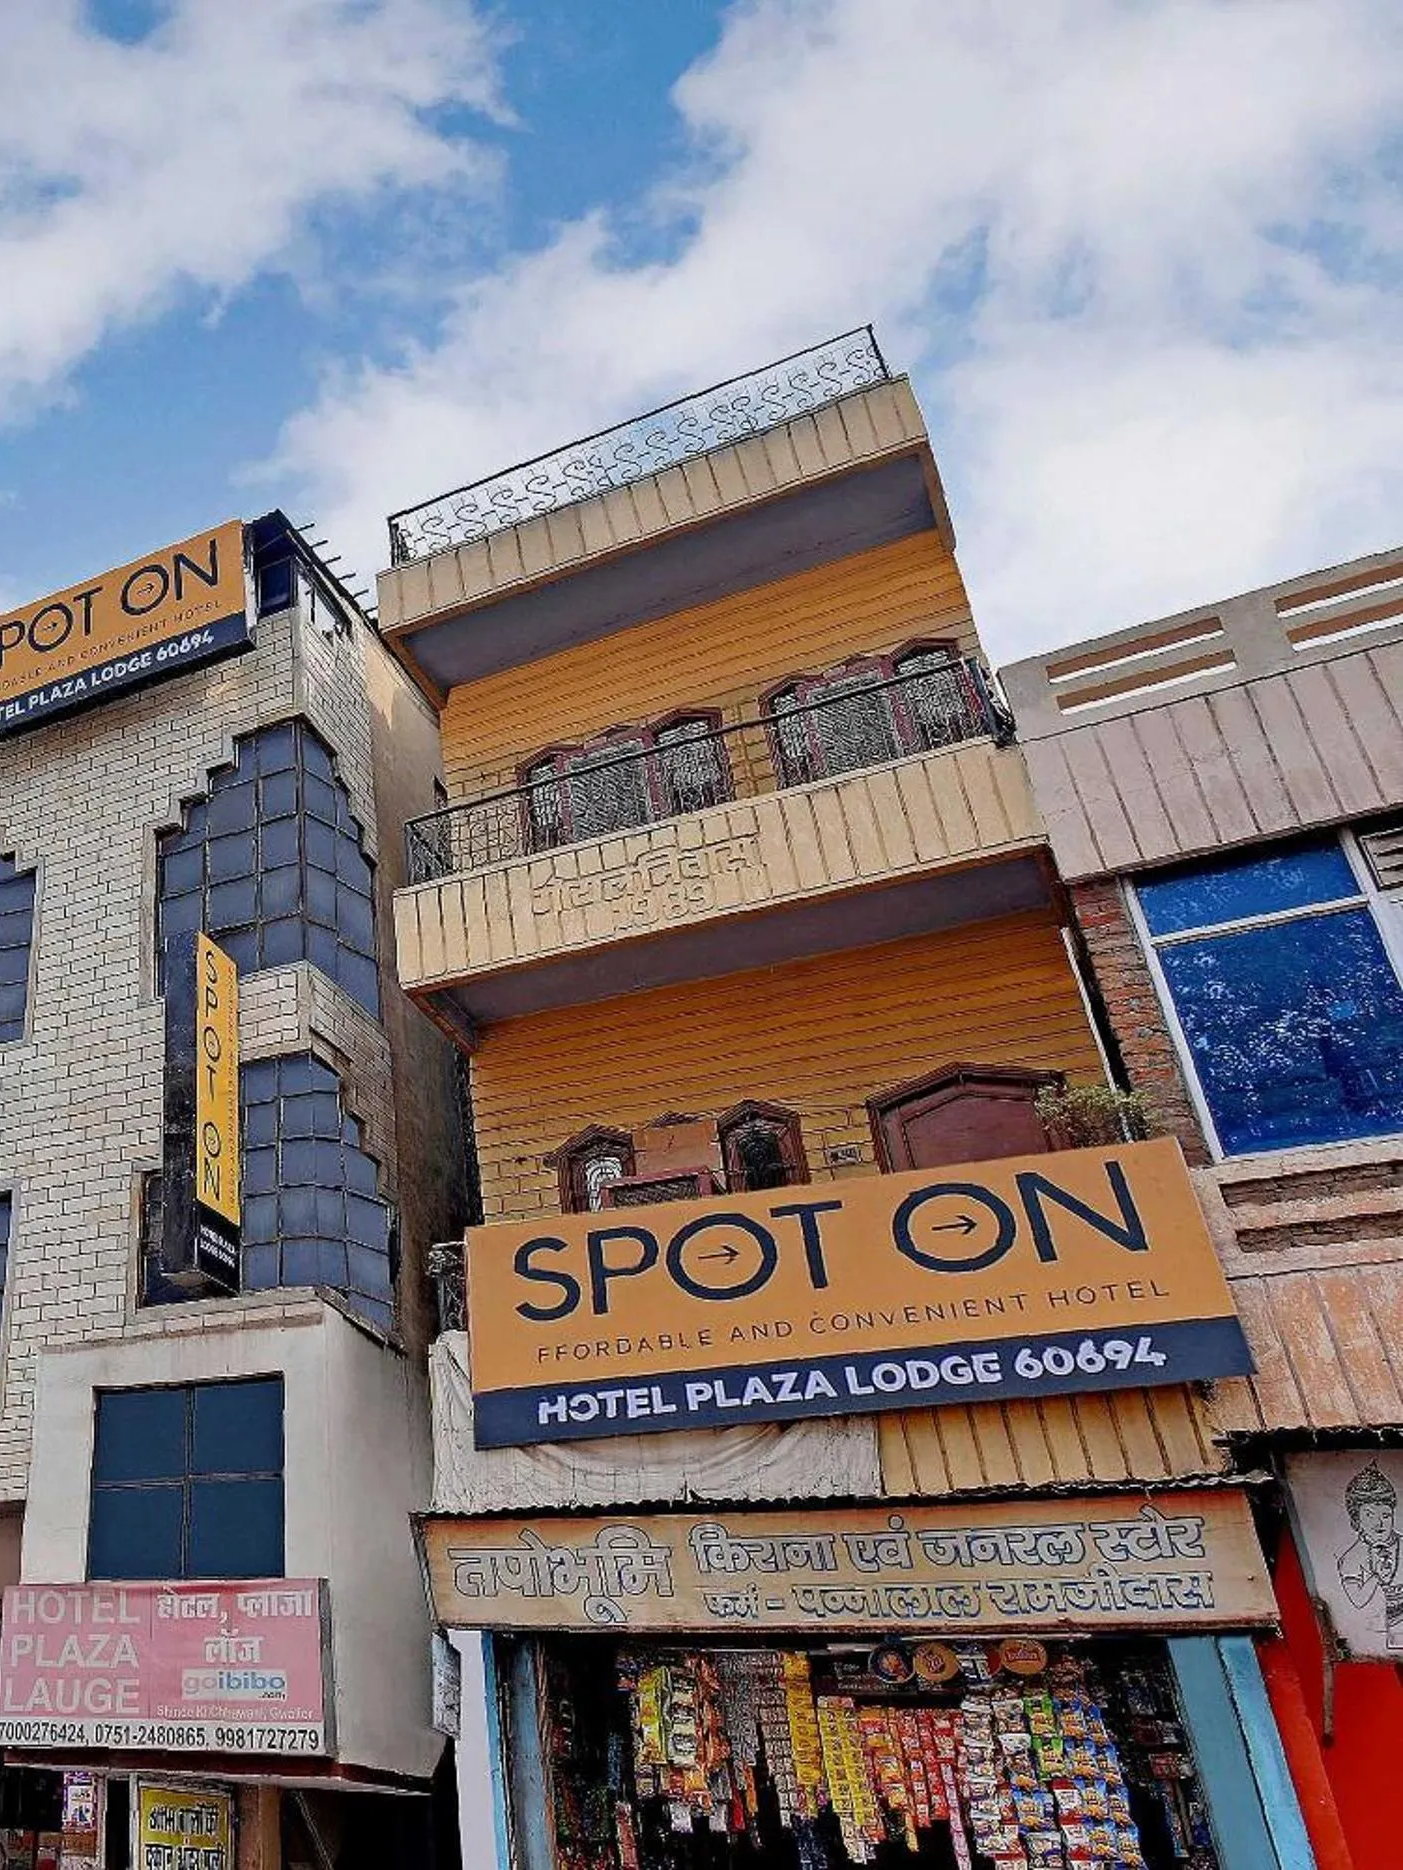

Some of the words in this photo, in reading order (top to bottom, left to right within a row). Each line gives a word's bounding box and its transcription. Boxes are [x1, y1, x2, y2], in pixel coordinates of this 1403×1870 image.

[121, 538, 219, 616] ON
[28, 676, 88, 711] PLAZA
[90, 650, 154, 687] LODGE
[155, 628, 215, 663] 60694
[203, 951, 222, 1103] SPOT
[202, 1119, 222, 1202] ON
[513, 1200, 843, 1322] SPOT
[891, 1160, 1149, 1273] ON
[537, 1329, 714, 1364] FFORDABLE
[729, 1320, 793, 1344] AND
[809, 1293, 1029, 1335] CONVENIENT
[1049, 1280, 1170, 1309] HOTEL
[538, 1383, 677, 1425] HOTEL
[685, 1368, 838, 1411] PLAZA
[844, 1352, 1004, 1397] LODGE
[1014, 1336, 1167, 1380] 60694
[689, 1521, 837, 1572] किराना
[843, 1515, 914, 1573] एवं
[917, 1522, 1089, 1568] जनरल
[1088, 1505, 1206, 1562] स्टोर
[11, 1590, 141, 1625] HOTEL
[236, 1590, 314, 1619] प्लाजा
[447, 1525, 674, 1624] तपोभूमि
[703, 1584, 760, 1620] फर्म
[791, 1583, 984, 1619] पन्नालाल
[986, 1562, 1215, 1613] रामजीदास
[11, 1634, 141, 1669] PLAZA
[204, 1628, 265, 1664] लॉज
[4, 1677, 141, 1715] LAUGE
[184, 1671, 286, 1696] goibibo
[215, 1726, 320, 1751] 9981727279
